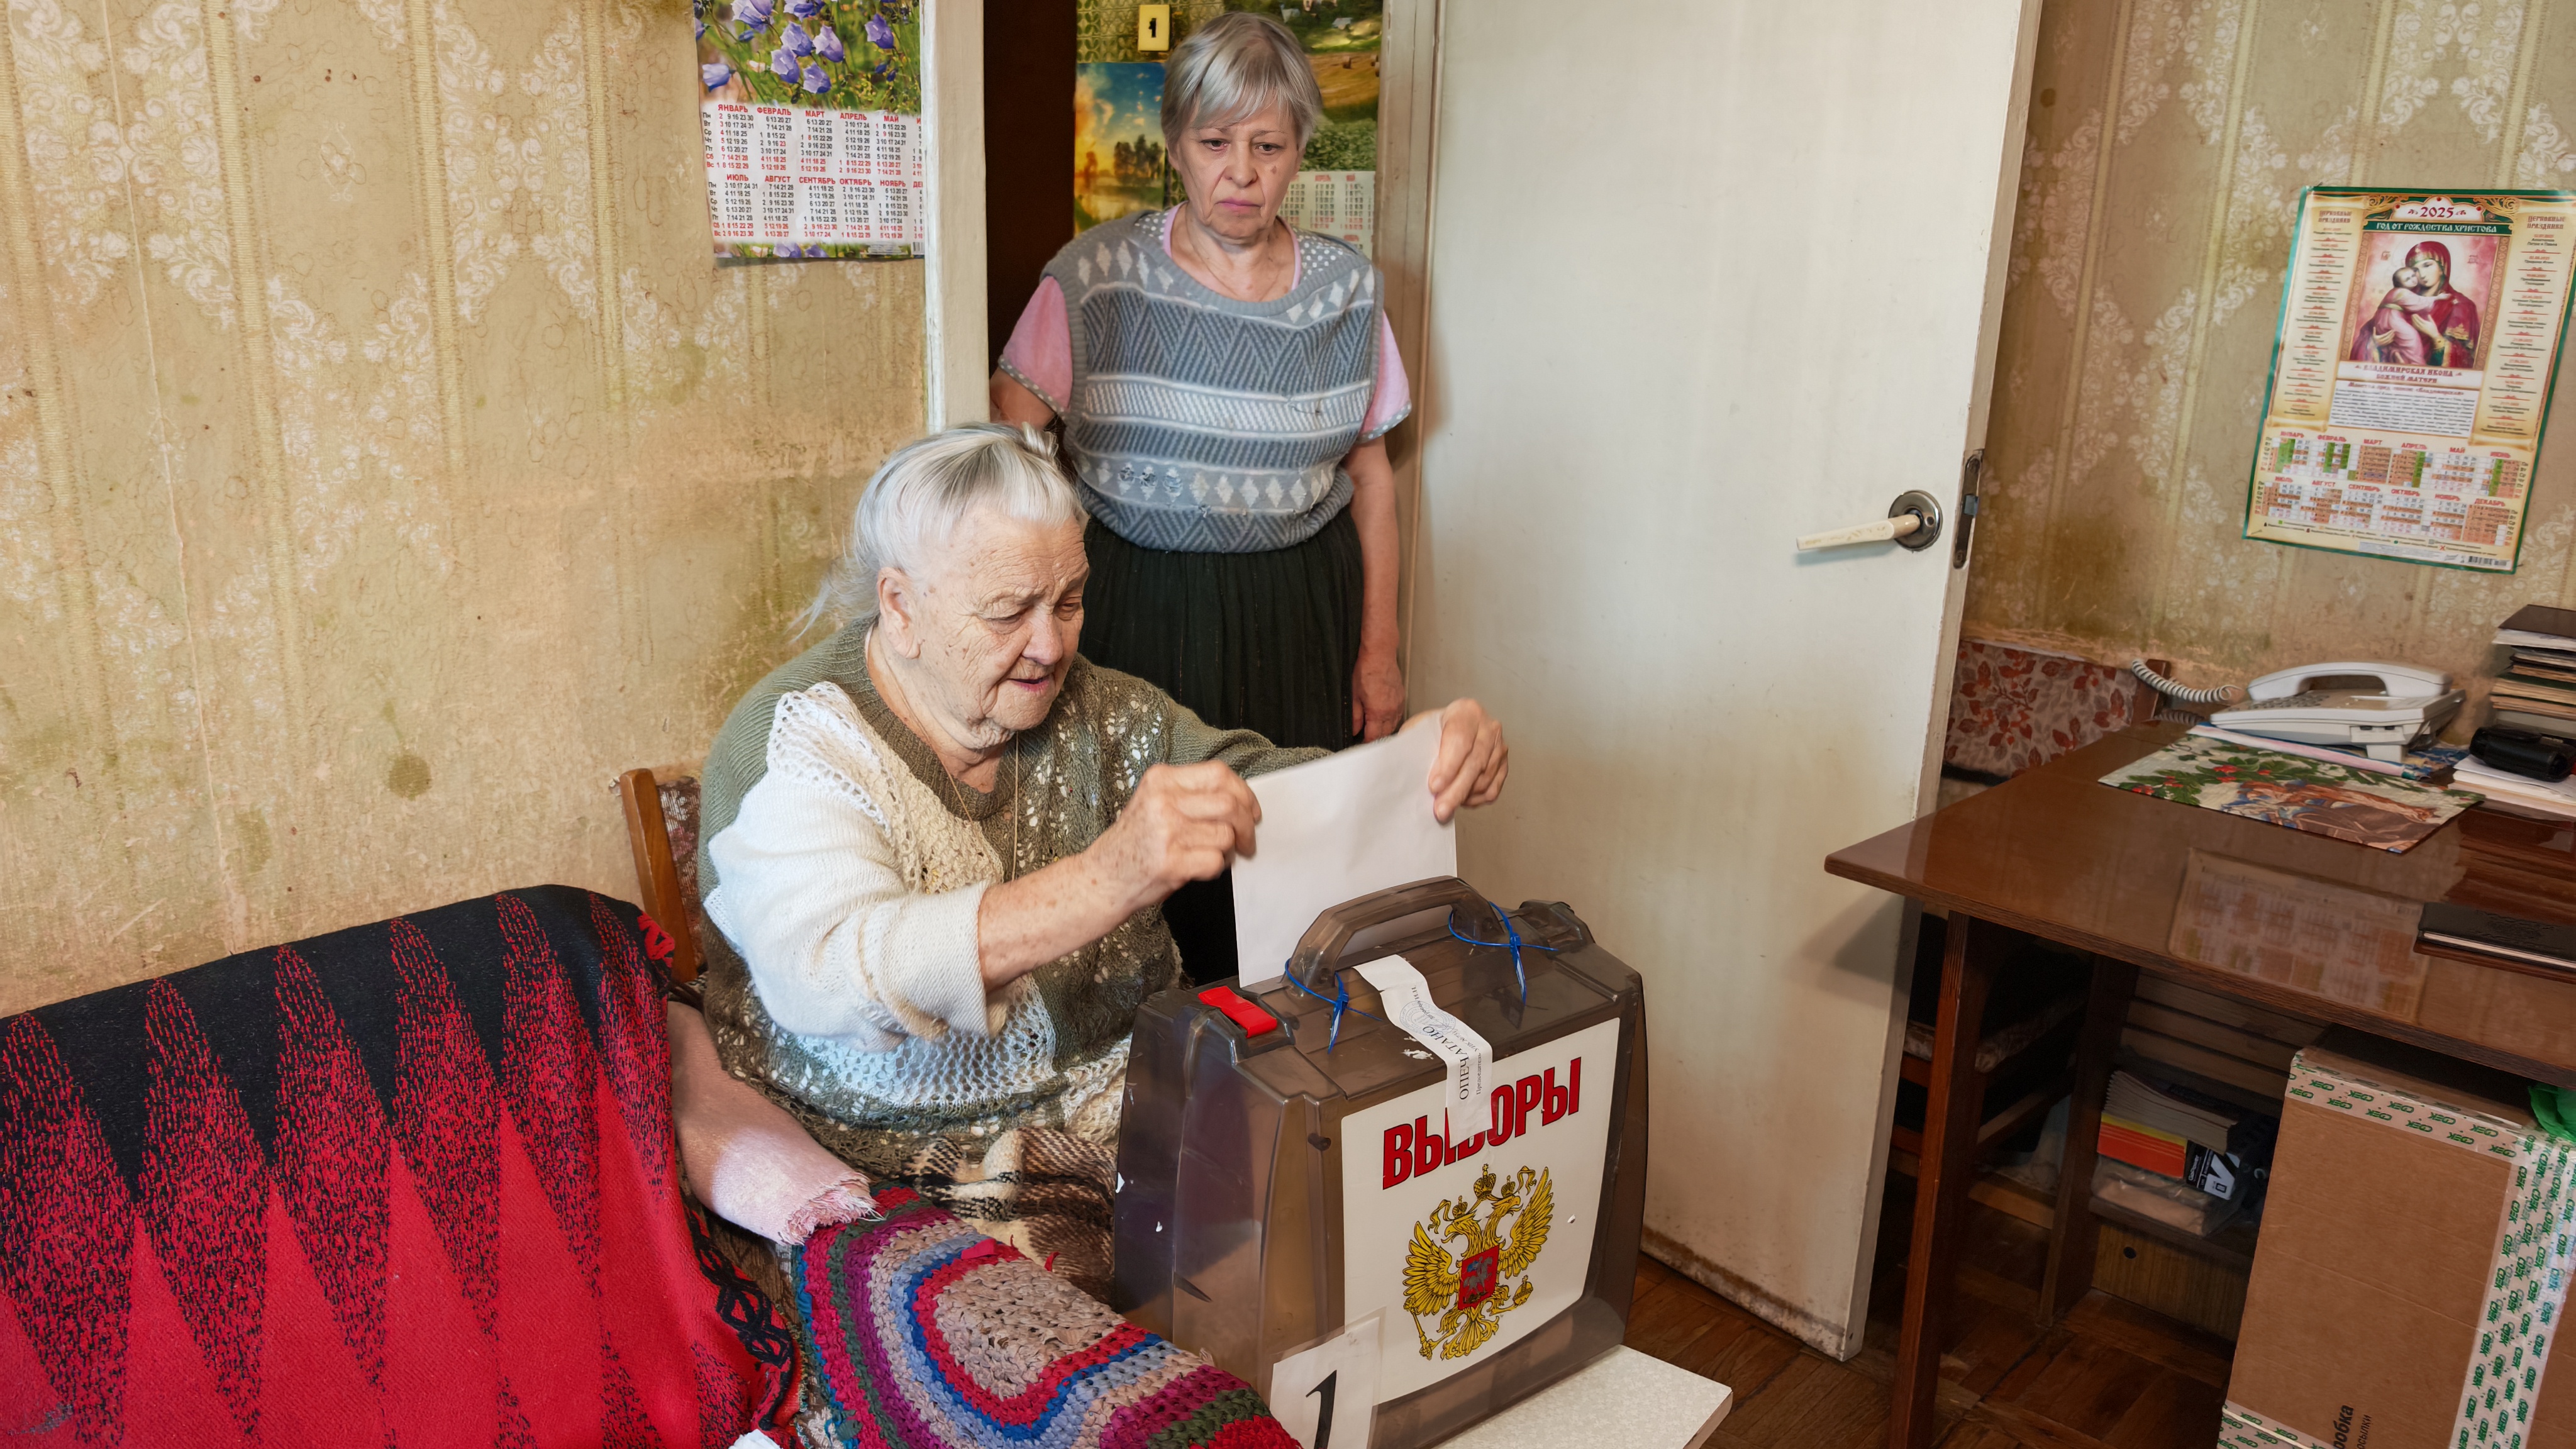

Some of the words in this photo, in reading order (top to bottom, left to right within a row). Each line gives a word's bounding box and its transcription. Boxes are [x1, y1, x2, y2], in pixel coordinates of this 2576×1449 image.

[1148, 17, 1157, 38] 1
[718, 104, 748, 113] ЯНВАРЬ
[757, 107, 791, 116] ФЕВРАЛЬ
[2420, 206, 2455, 218] 2025
[2377, 222, 2390, 231] ГОД
[2404, 223, 2452, 231] РОЖДЕСТВА
[2453, 225, 2497, 233] ХРИСТОВА
[2364, 365, 2425, 375] ВЛАДИМИРСКАЯ
[2475, 498, 2506, 506] ДЕКАБРЬ
[1423, 1026, 1469, 1099] ОПЕЧАТАНО
[1382, 1056, 1582, 1191] ВЫОРЫ
[2536, 1153, 2548, 1177] CDEK
[2515, 1165, 2527, 1190] CDEK
[2550, 1177, 2561, 1201] CDEK
[2529, 1189, 2540, 1212] CDEK
[2563, 1199, 2575, 1223] CDEK
[2509, 1201, 2520, 1224] CDEK
[2542, 1212, 2553, 1236] CDEK
[2502, 1235, 2512, 1257] CDEK
[2521, 1223, 2533, 1246] CDEK
[2556, 1234, 2567, 1257] CDEK
[2534, 1246, 2546, 1270] CDEK
[1306, 1370, 1337, 1449] 1
